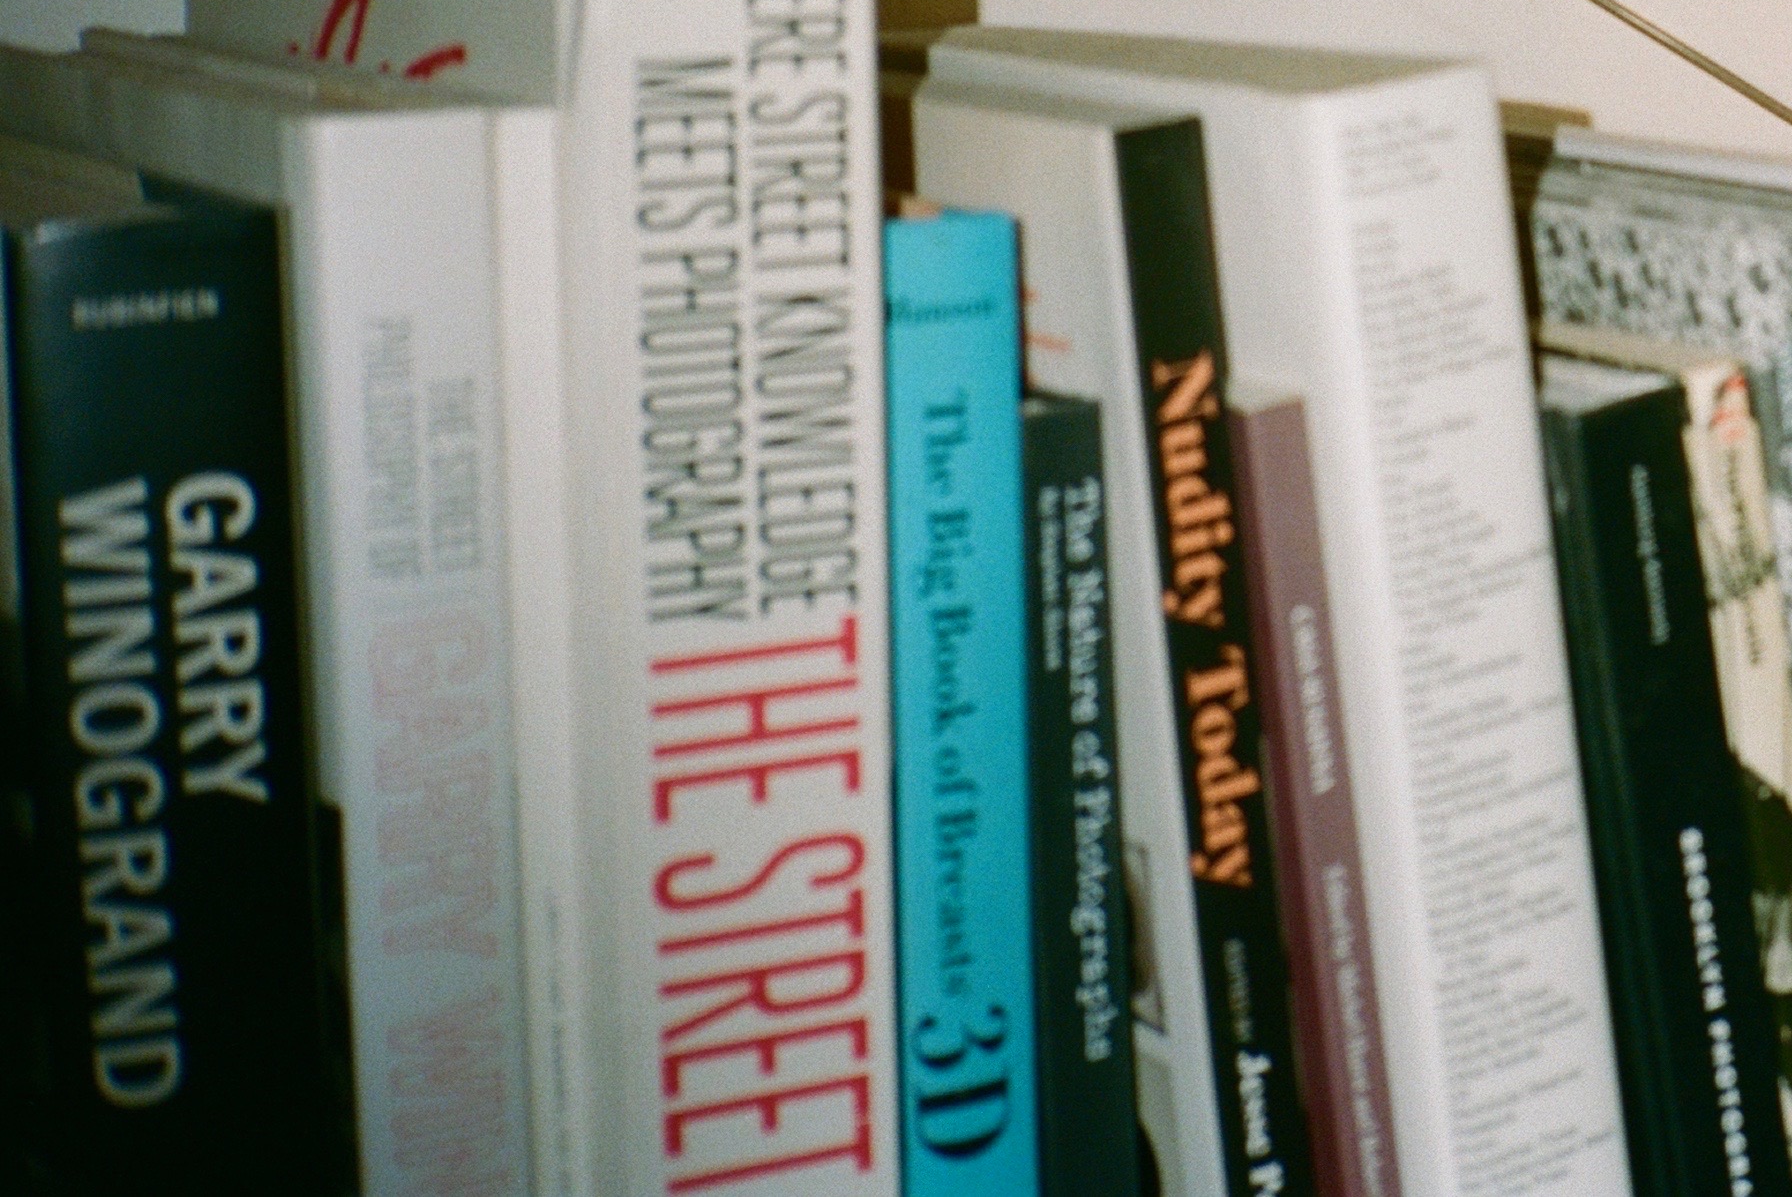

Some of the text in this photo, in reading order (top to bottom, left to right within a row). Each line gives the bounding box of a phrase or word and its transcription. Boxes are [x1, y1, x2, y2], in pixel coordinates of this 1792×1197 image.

[633, 54, 750, 624] MEETS PHOTOGRAPHY
[748, 90, 851, 270] STREET
[164, 470, 270, 805] GARRY
[755, 288, 858, 615] KNOWLEDGE
[1151, 350, 1260, 887] Nudity Today
[56, 475, 184, 1110] WINOGRAND
[367, 608, 500, 959] GARRY
[649, 615, 874, 1197] THE STREET
[910, 388, 1009, 1160] The Big Book of Breasts 3D
[1065, 475, 1119, 1063] The Nature of Photographs
[1678, 826, 1727, 1012] BROOKLYN
[1235, 1052, 1273, 1156] Jesse
